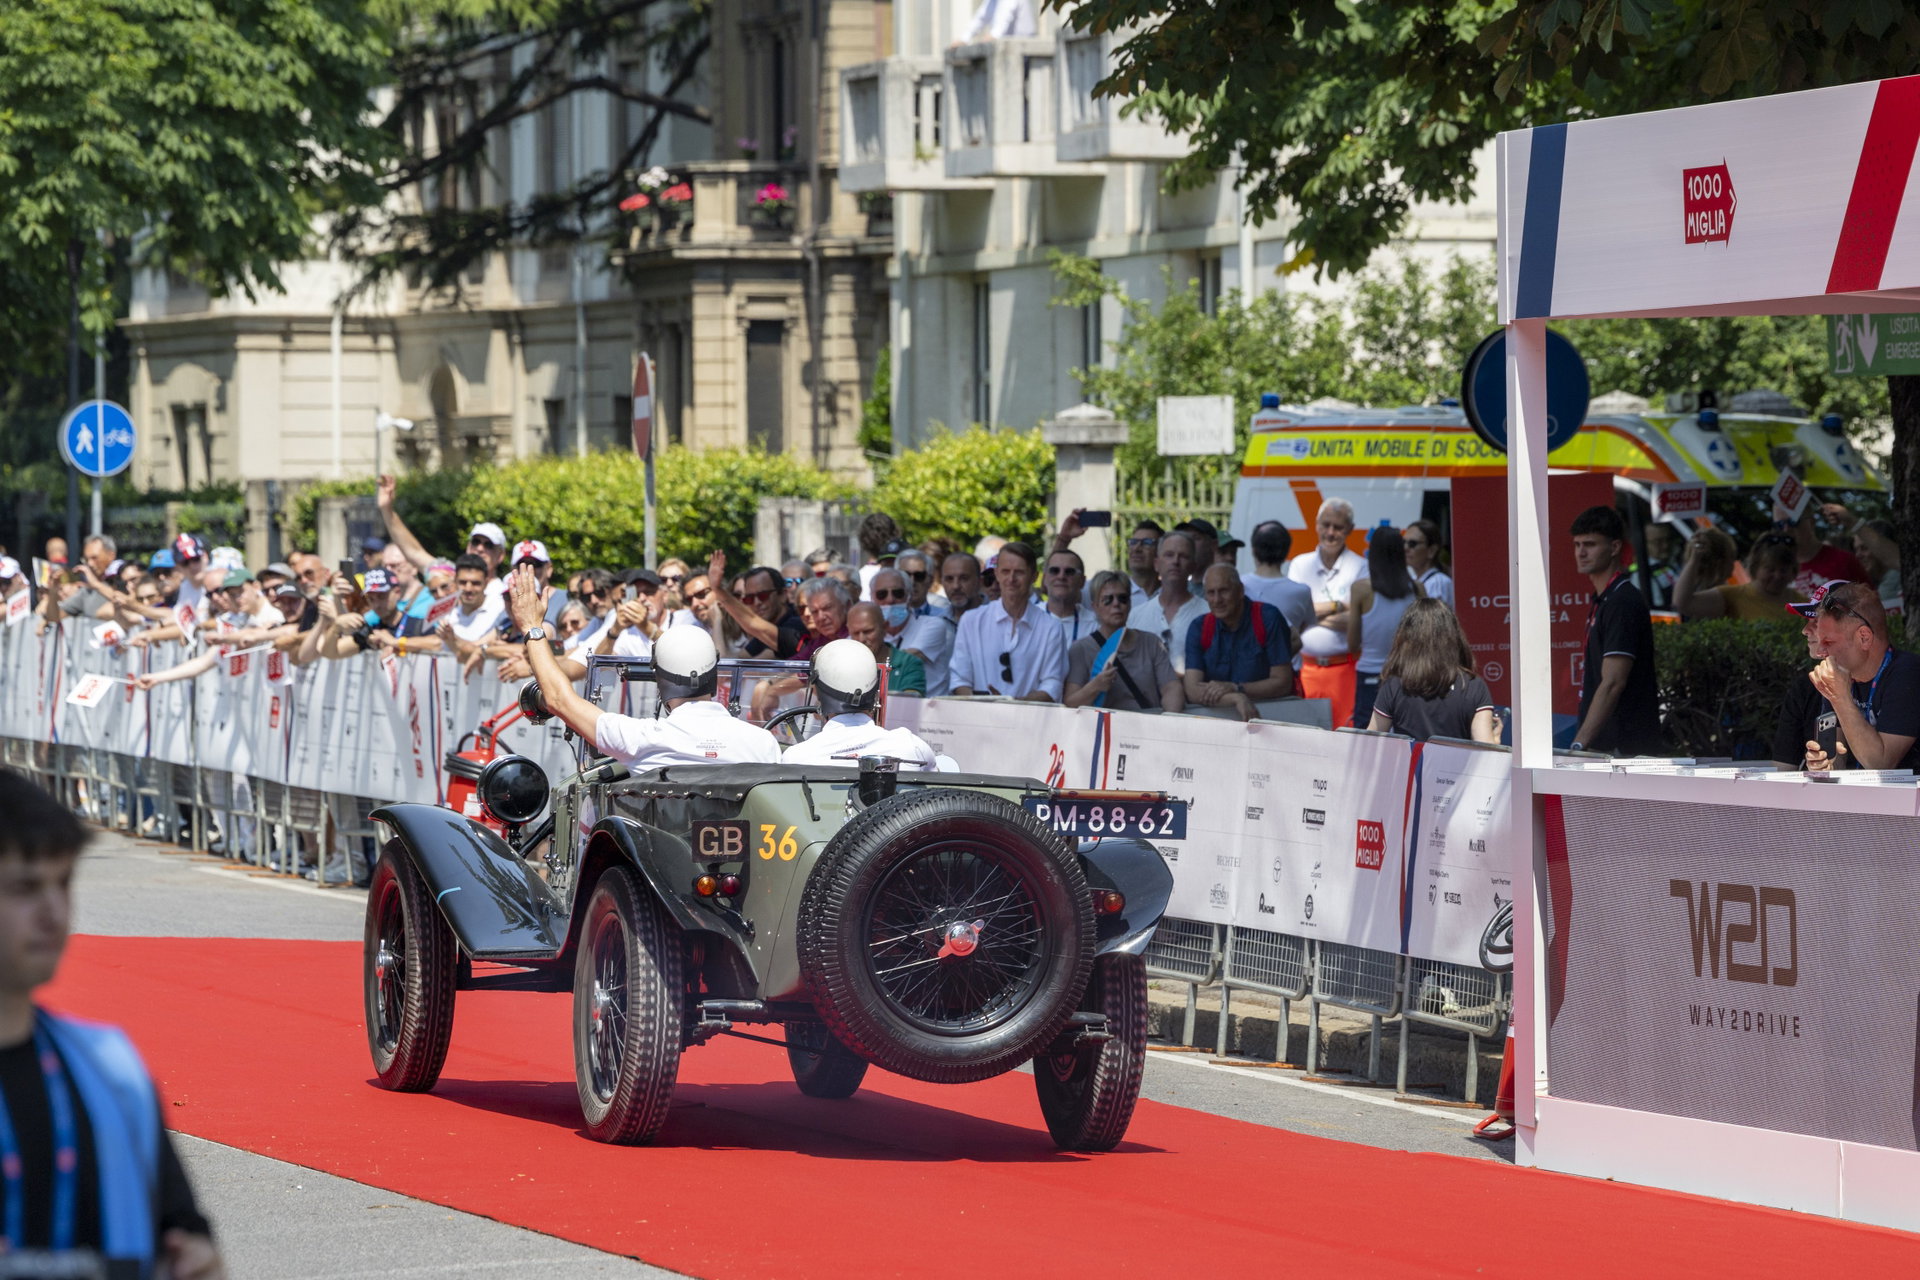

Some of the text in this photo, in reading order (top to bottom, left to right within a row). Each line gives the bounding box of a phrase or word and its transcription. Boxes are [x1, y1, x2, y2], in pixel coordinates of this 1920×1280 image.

[1688, 173, 1722, 200] 1000
[1687, 208, 1726, 238] MIGLIA
[1364, 439, 1425, 458] MOBILE
[1432, 439, 1449, 457] DI
[699, 826, 743, 856] GB
[758, 823, 798, 861] 36
[1359, 824, 1380, 844] 1000
[1356, 847, 1380, 867] MIGLIA
[1688, 1003, 1801, 1039] WAY2DRIVE
